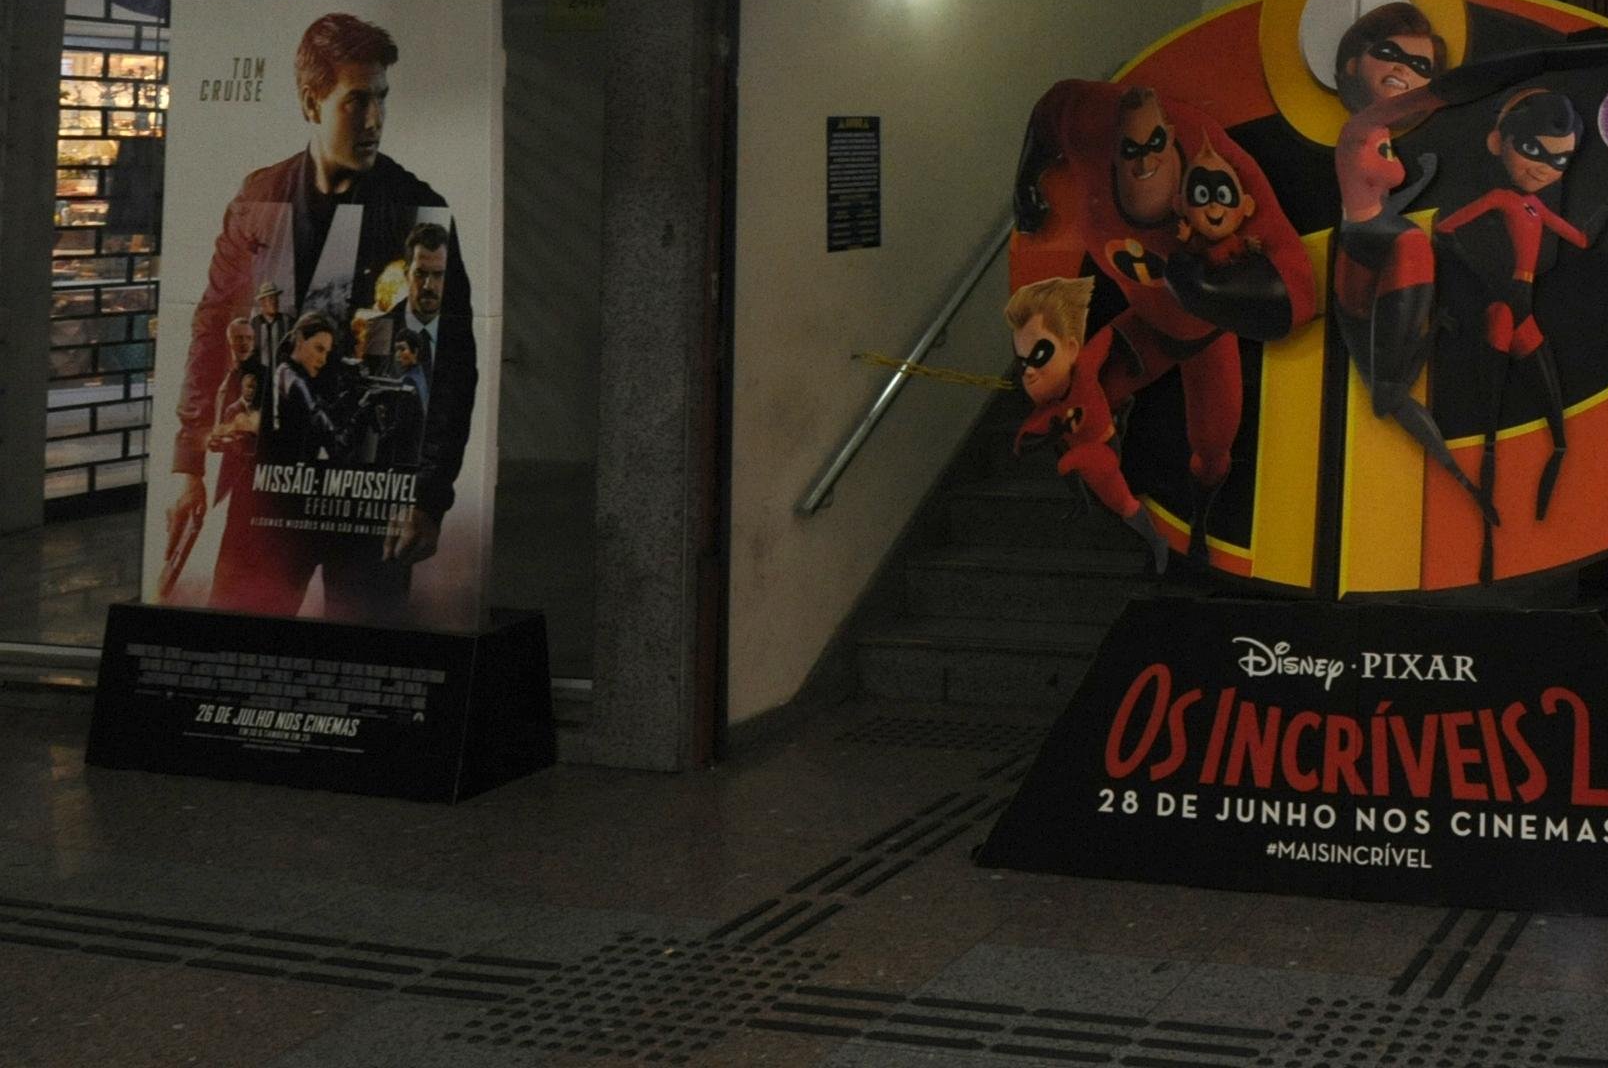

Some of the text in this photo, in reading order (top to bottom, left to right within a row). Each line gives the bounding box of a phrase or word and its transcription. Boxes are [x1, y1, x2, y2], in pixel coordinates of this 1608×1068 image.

[232, 57, 266, 80] TOM
[199, 79, 264, 102] CRUISE
[252, 463, 417, 502] MISSÃO: IMPOSSÍVEL
[304, 497, 417, 523] EFEITO FALLOUT
[1360, 652, 1478, 683] PIXAR
[195, 703, 216, 723] 26
[214, 706, 235, 724] DE
[231, 707, 277, 728] JULHO
[274, 710, 304, 731] NOS
[303, 713, 361, 738] CINEMAS
[1199, 686, 1549, 805] INCRÍVEIS
[1097, 788, 1140, 815] 28
[1156, 792, 1199, 820] DE
[1214, 795, 1338, 829] JUNHO
[1354, 806, 1432, 835] NOS
[1265, 839, 1433, 870] #MAISINCRÍVEL
